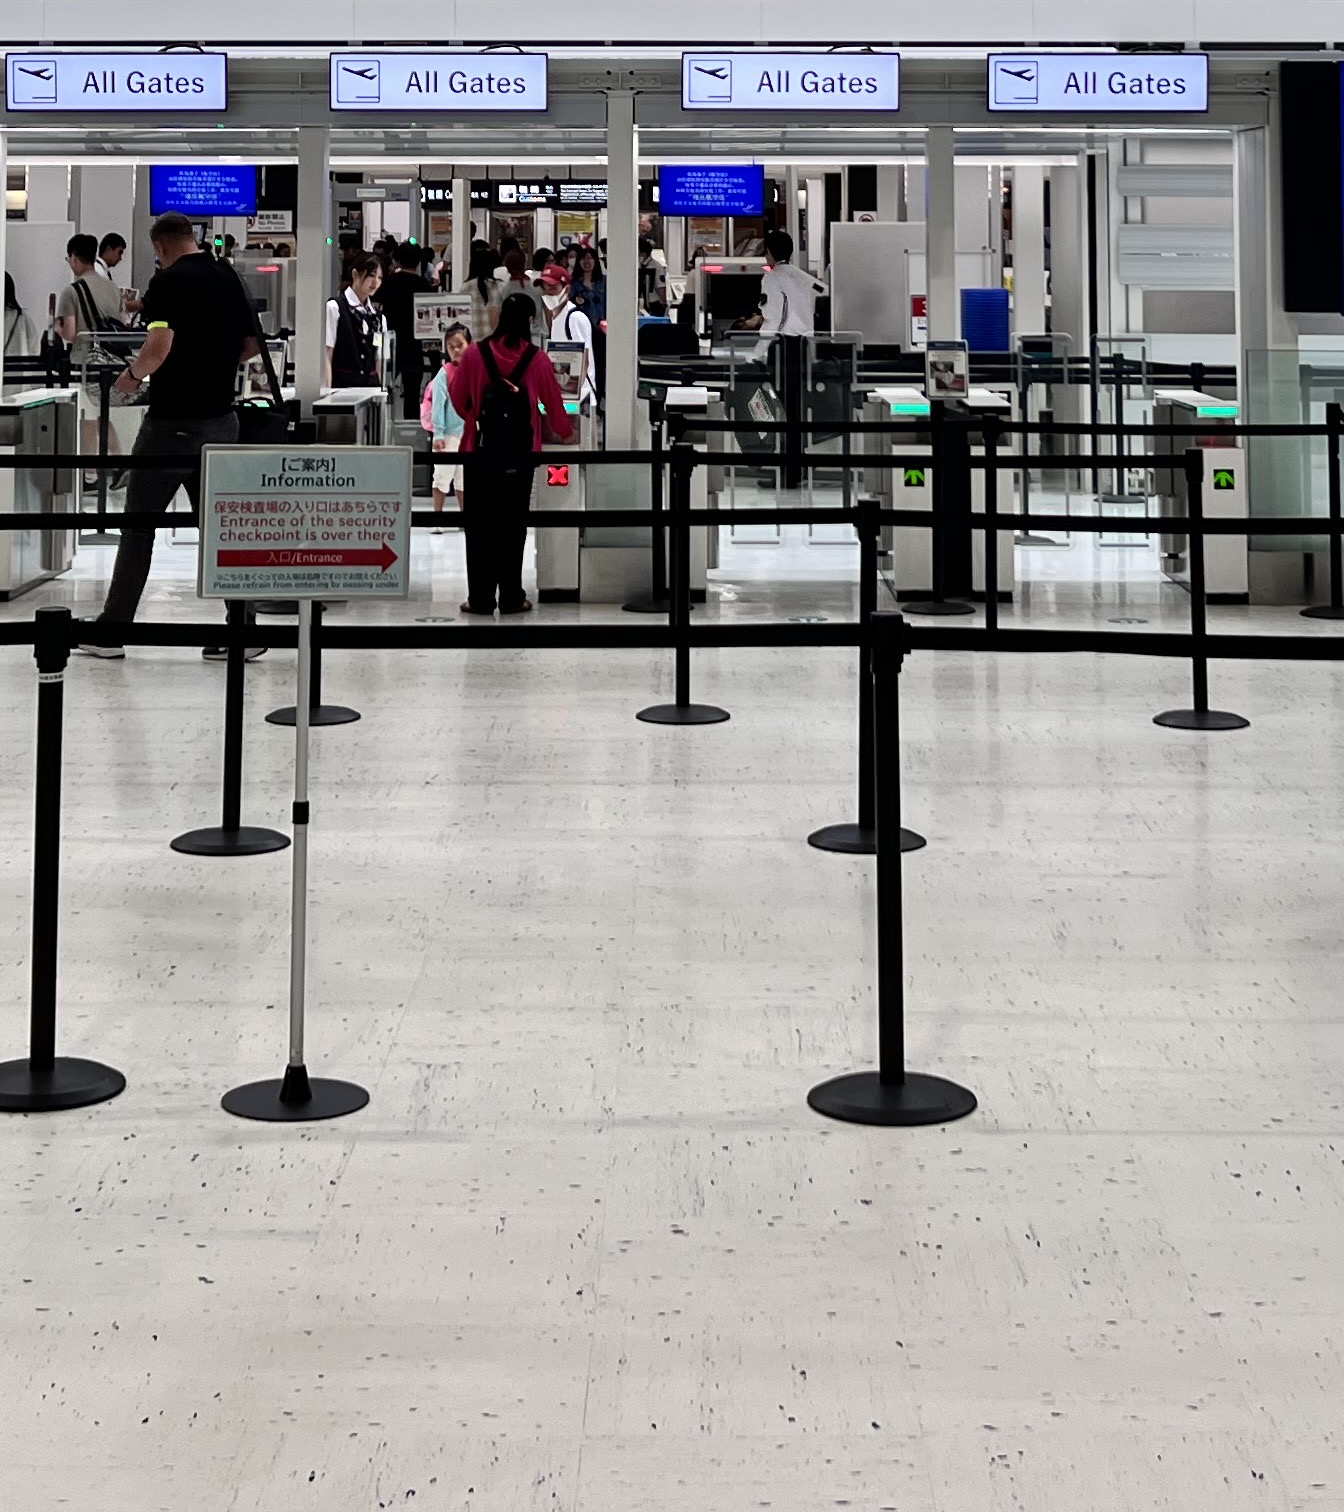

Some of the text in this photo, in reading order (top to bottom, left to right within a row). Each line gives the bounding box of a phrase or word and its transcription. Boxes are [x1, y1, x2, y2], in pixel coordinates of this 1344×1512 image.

[83, 70, 205, 94] All Gates
[405, 70, 526, 94] All Gates
[757, 70, 878, 94] All Gates
[1063, 71, 1186, 95] All Gates
[281, 457, 336, 472] 【ご案内】
[261, 473, 356, 487] Information
[214, 500, 403, 514] 保安検査場の入り口はあちらです
[220, 514, 397, 528] Entrance of the security
[219, 528, 396, 543] checkpoint is over there
[213, 581, 240, 589] Please
[242, 581, 272, 589] refrain
[273, 581, 293, 589] from
[375, 581, 399, 589] under
